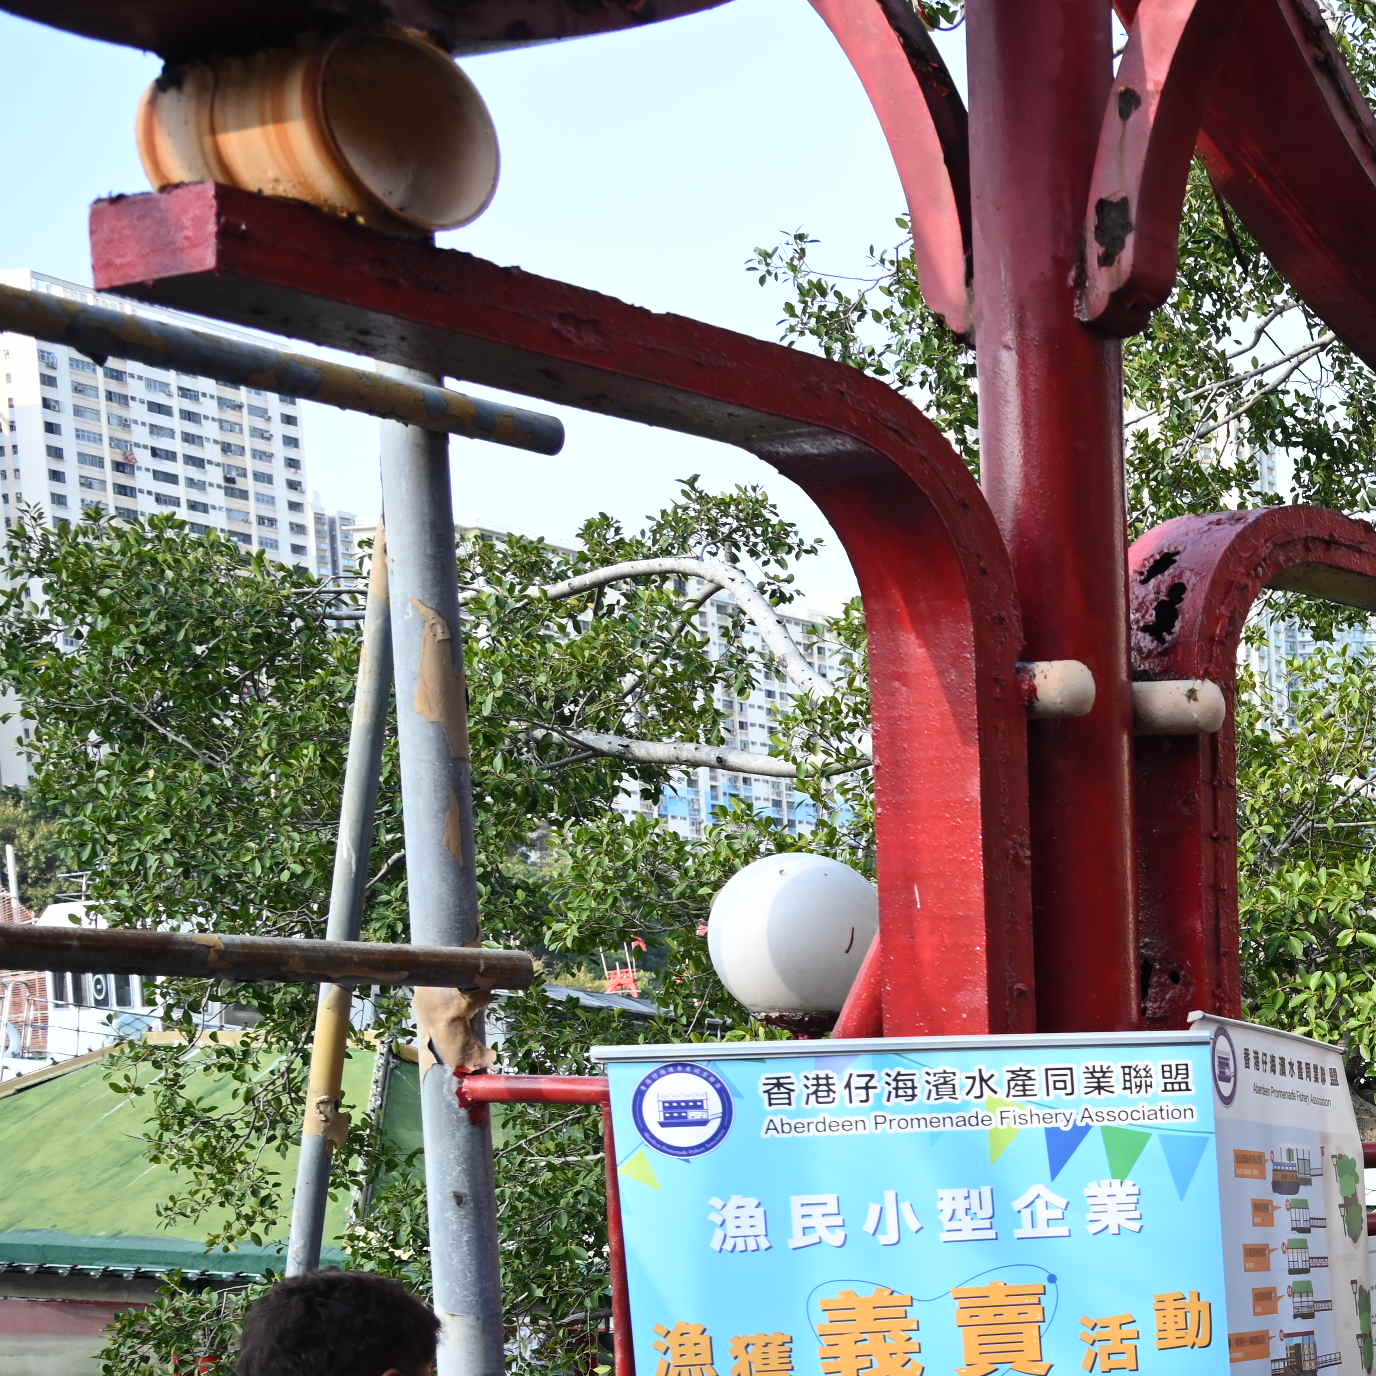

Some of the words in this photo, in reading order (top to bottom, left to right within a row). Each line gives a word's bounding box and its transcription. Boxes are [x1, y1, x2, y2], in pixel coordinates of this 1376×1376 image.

[762, 1063, 1192, 1108] 香港仔海濱水產同業聯盟
[764, 1115, 867, 1136] Aberdeen
[873, 1110, 993, 1131] Promenade
[999, 1108, 1074, 1127] Fishery
[1079, 1105, 1195, 1123] Association
[708, 1180, 1144, 1254] 漁民小型企業
